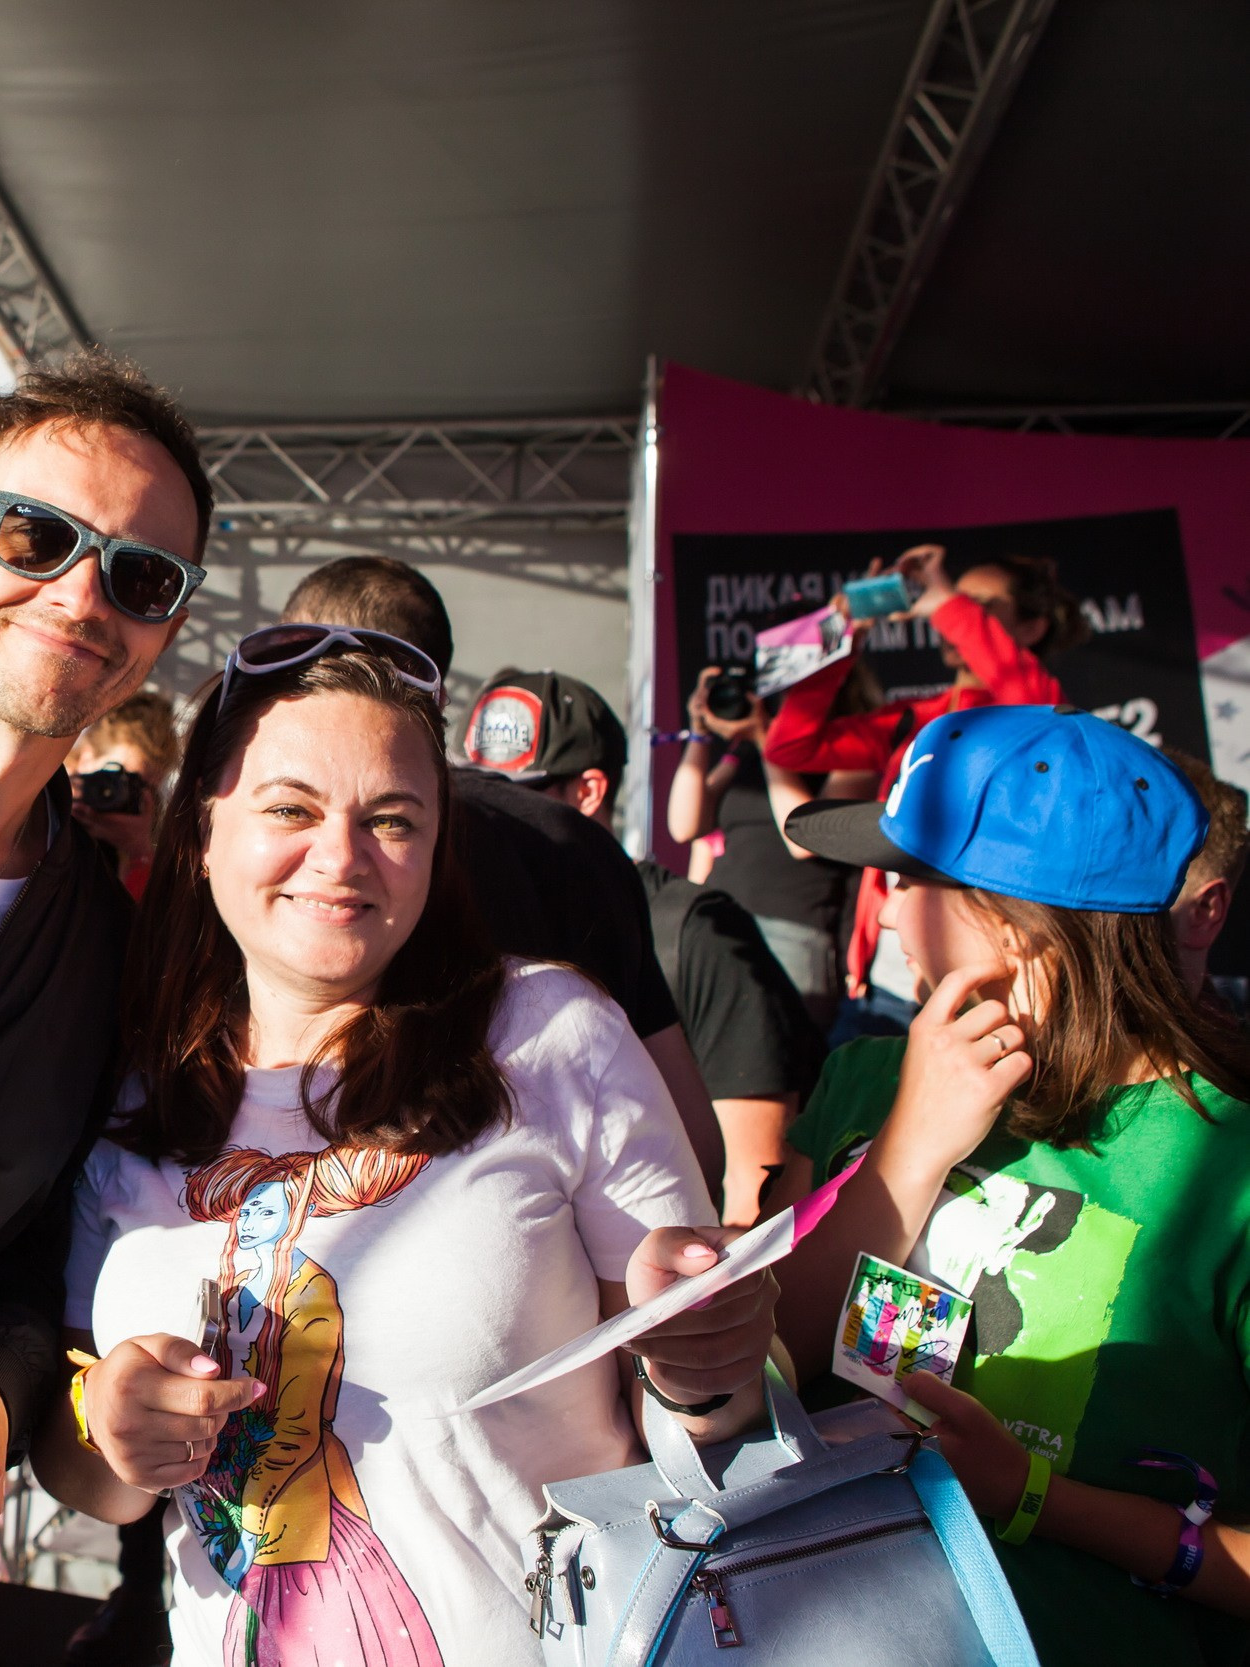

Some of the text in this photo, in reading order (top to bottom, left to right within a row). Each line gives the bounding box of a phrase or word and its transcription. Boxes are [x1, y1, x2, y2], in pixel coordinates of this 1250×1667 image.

[705, 571, 825, 620] ДИКАЯ
[705, 619, 756, 662] ПО
[1182, 1543, 1198, 1572] 2018
